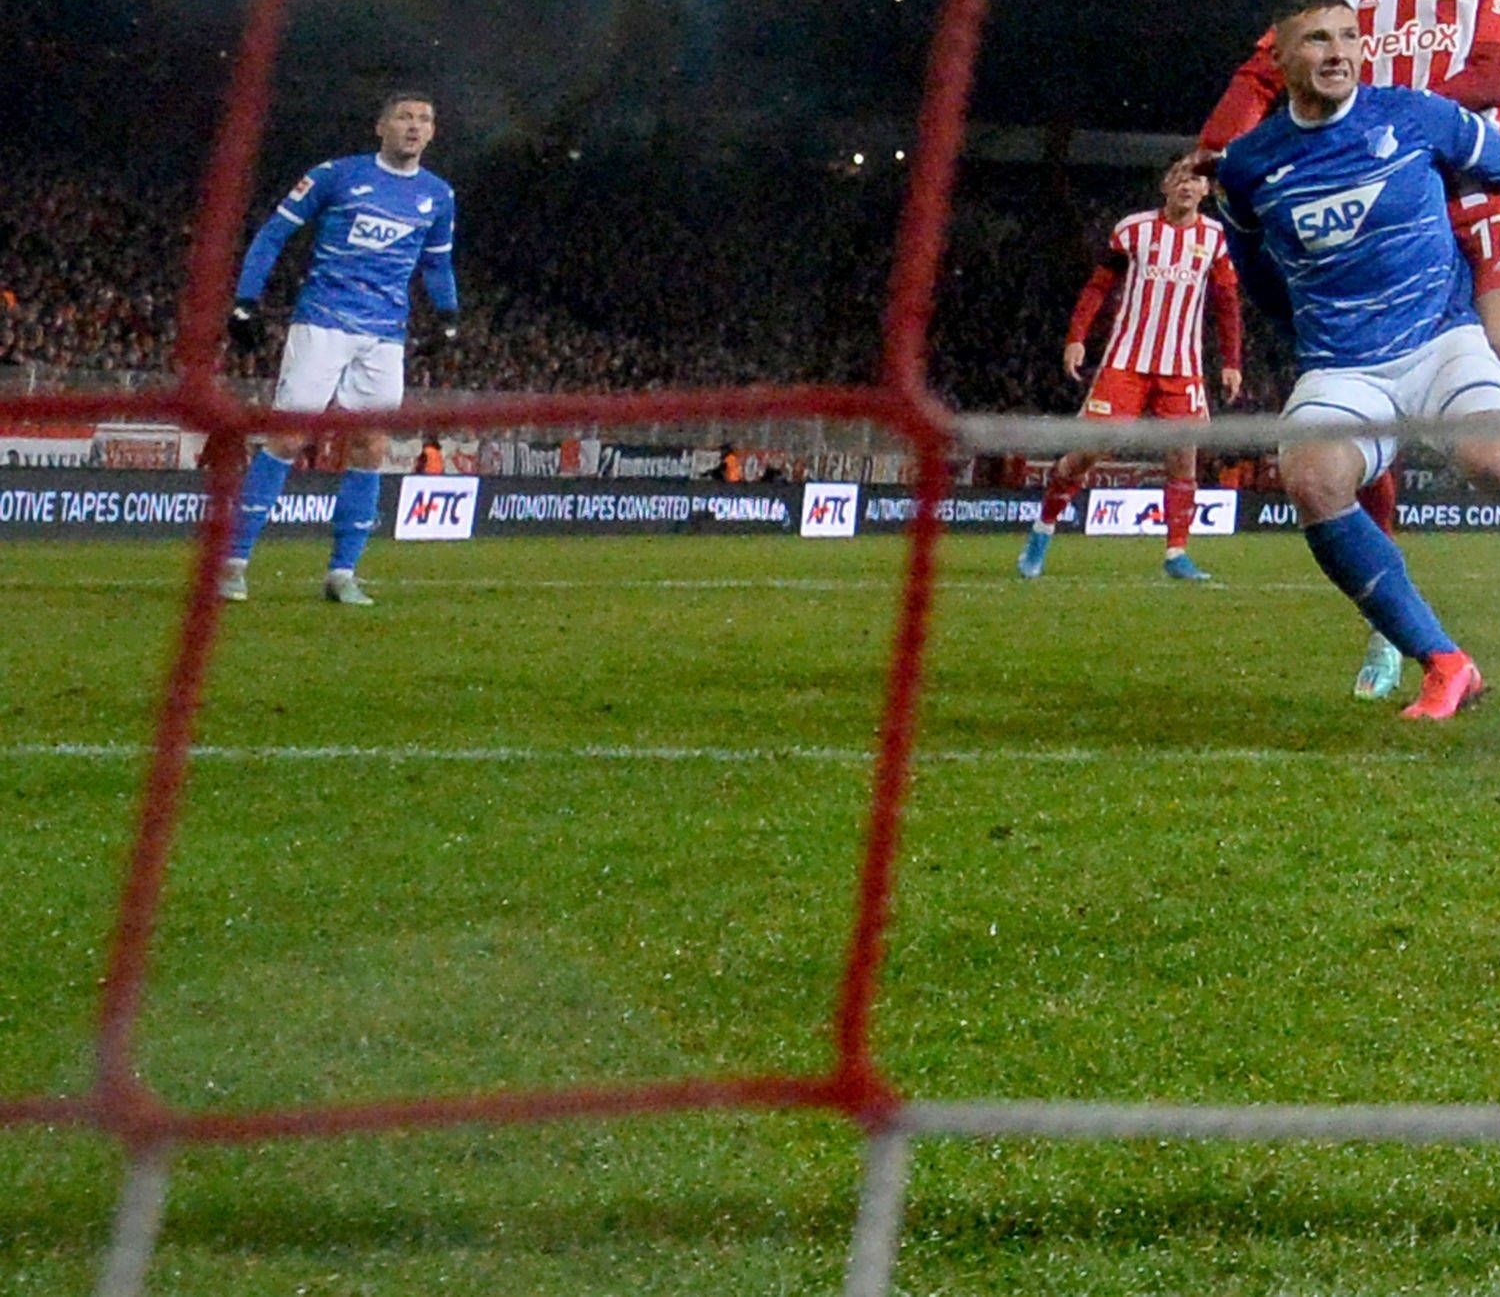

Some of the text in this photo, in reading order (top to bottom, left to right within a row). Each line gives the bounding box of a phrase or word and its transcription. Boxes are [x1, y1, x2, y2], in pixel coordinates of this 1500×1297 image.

[1361, 22, 1457, 63] wefox
[353, 221, 397, 242] SAP
[1298, 199, 1365, 242] SAP
[61, 491, 116, 522] TAPES
[124, 492, 209, 522] CONVERT
[404, 491, 468, 526] AFTC
[489, 494, 572, 521] AUTOMOTIVE
[577, 494, 616, 521] TAPES
[617, 495, 690, 521] CONVERTED
[806, 499, 850, 525] AFTC
[1397, 505, 1460, 526] TAPES
